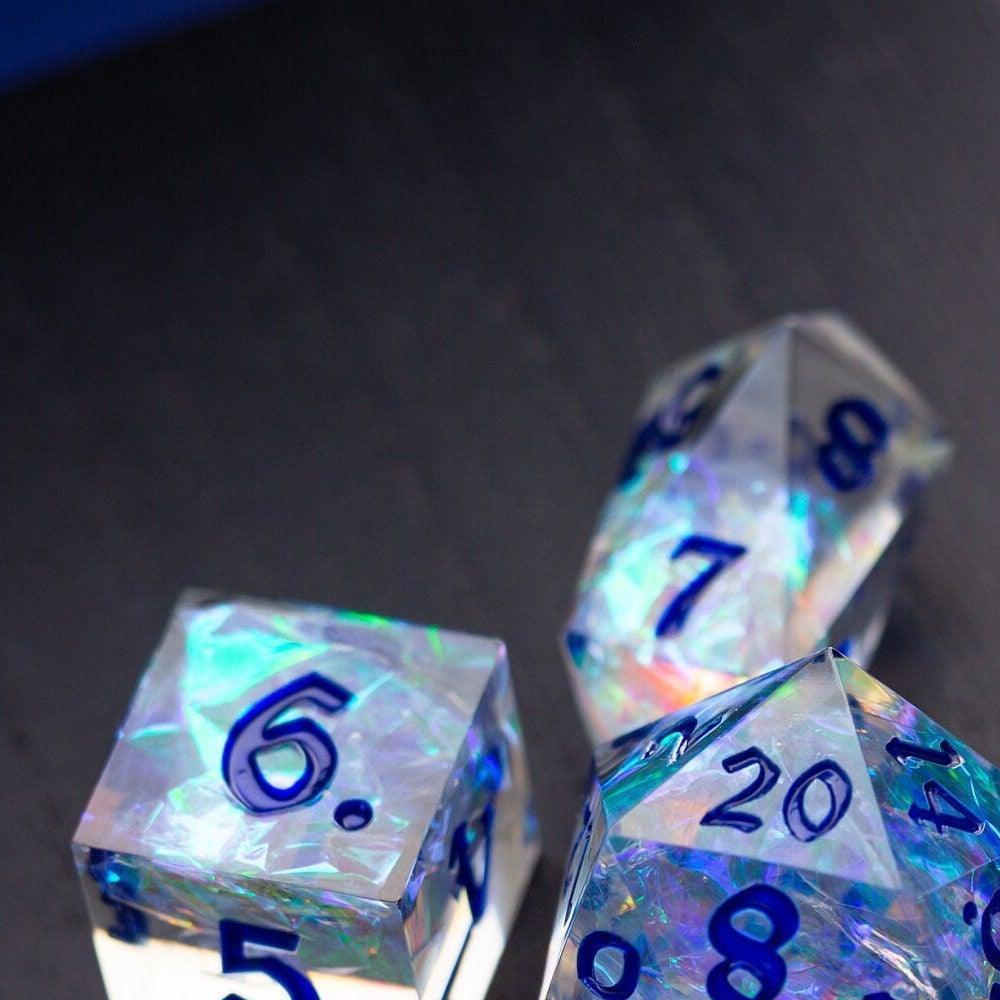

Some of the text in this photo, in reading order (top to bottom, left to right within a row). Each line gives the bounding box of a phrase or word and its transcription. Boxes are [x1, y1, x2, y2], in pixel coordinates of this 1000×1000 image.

[817, 397, 889, 492] 8
[655, 535, 748, 638] 7
[700, 746, 854, 842] 20
[885, 736, 986, 836] 14
